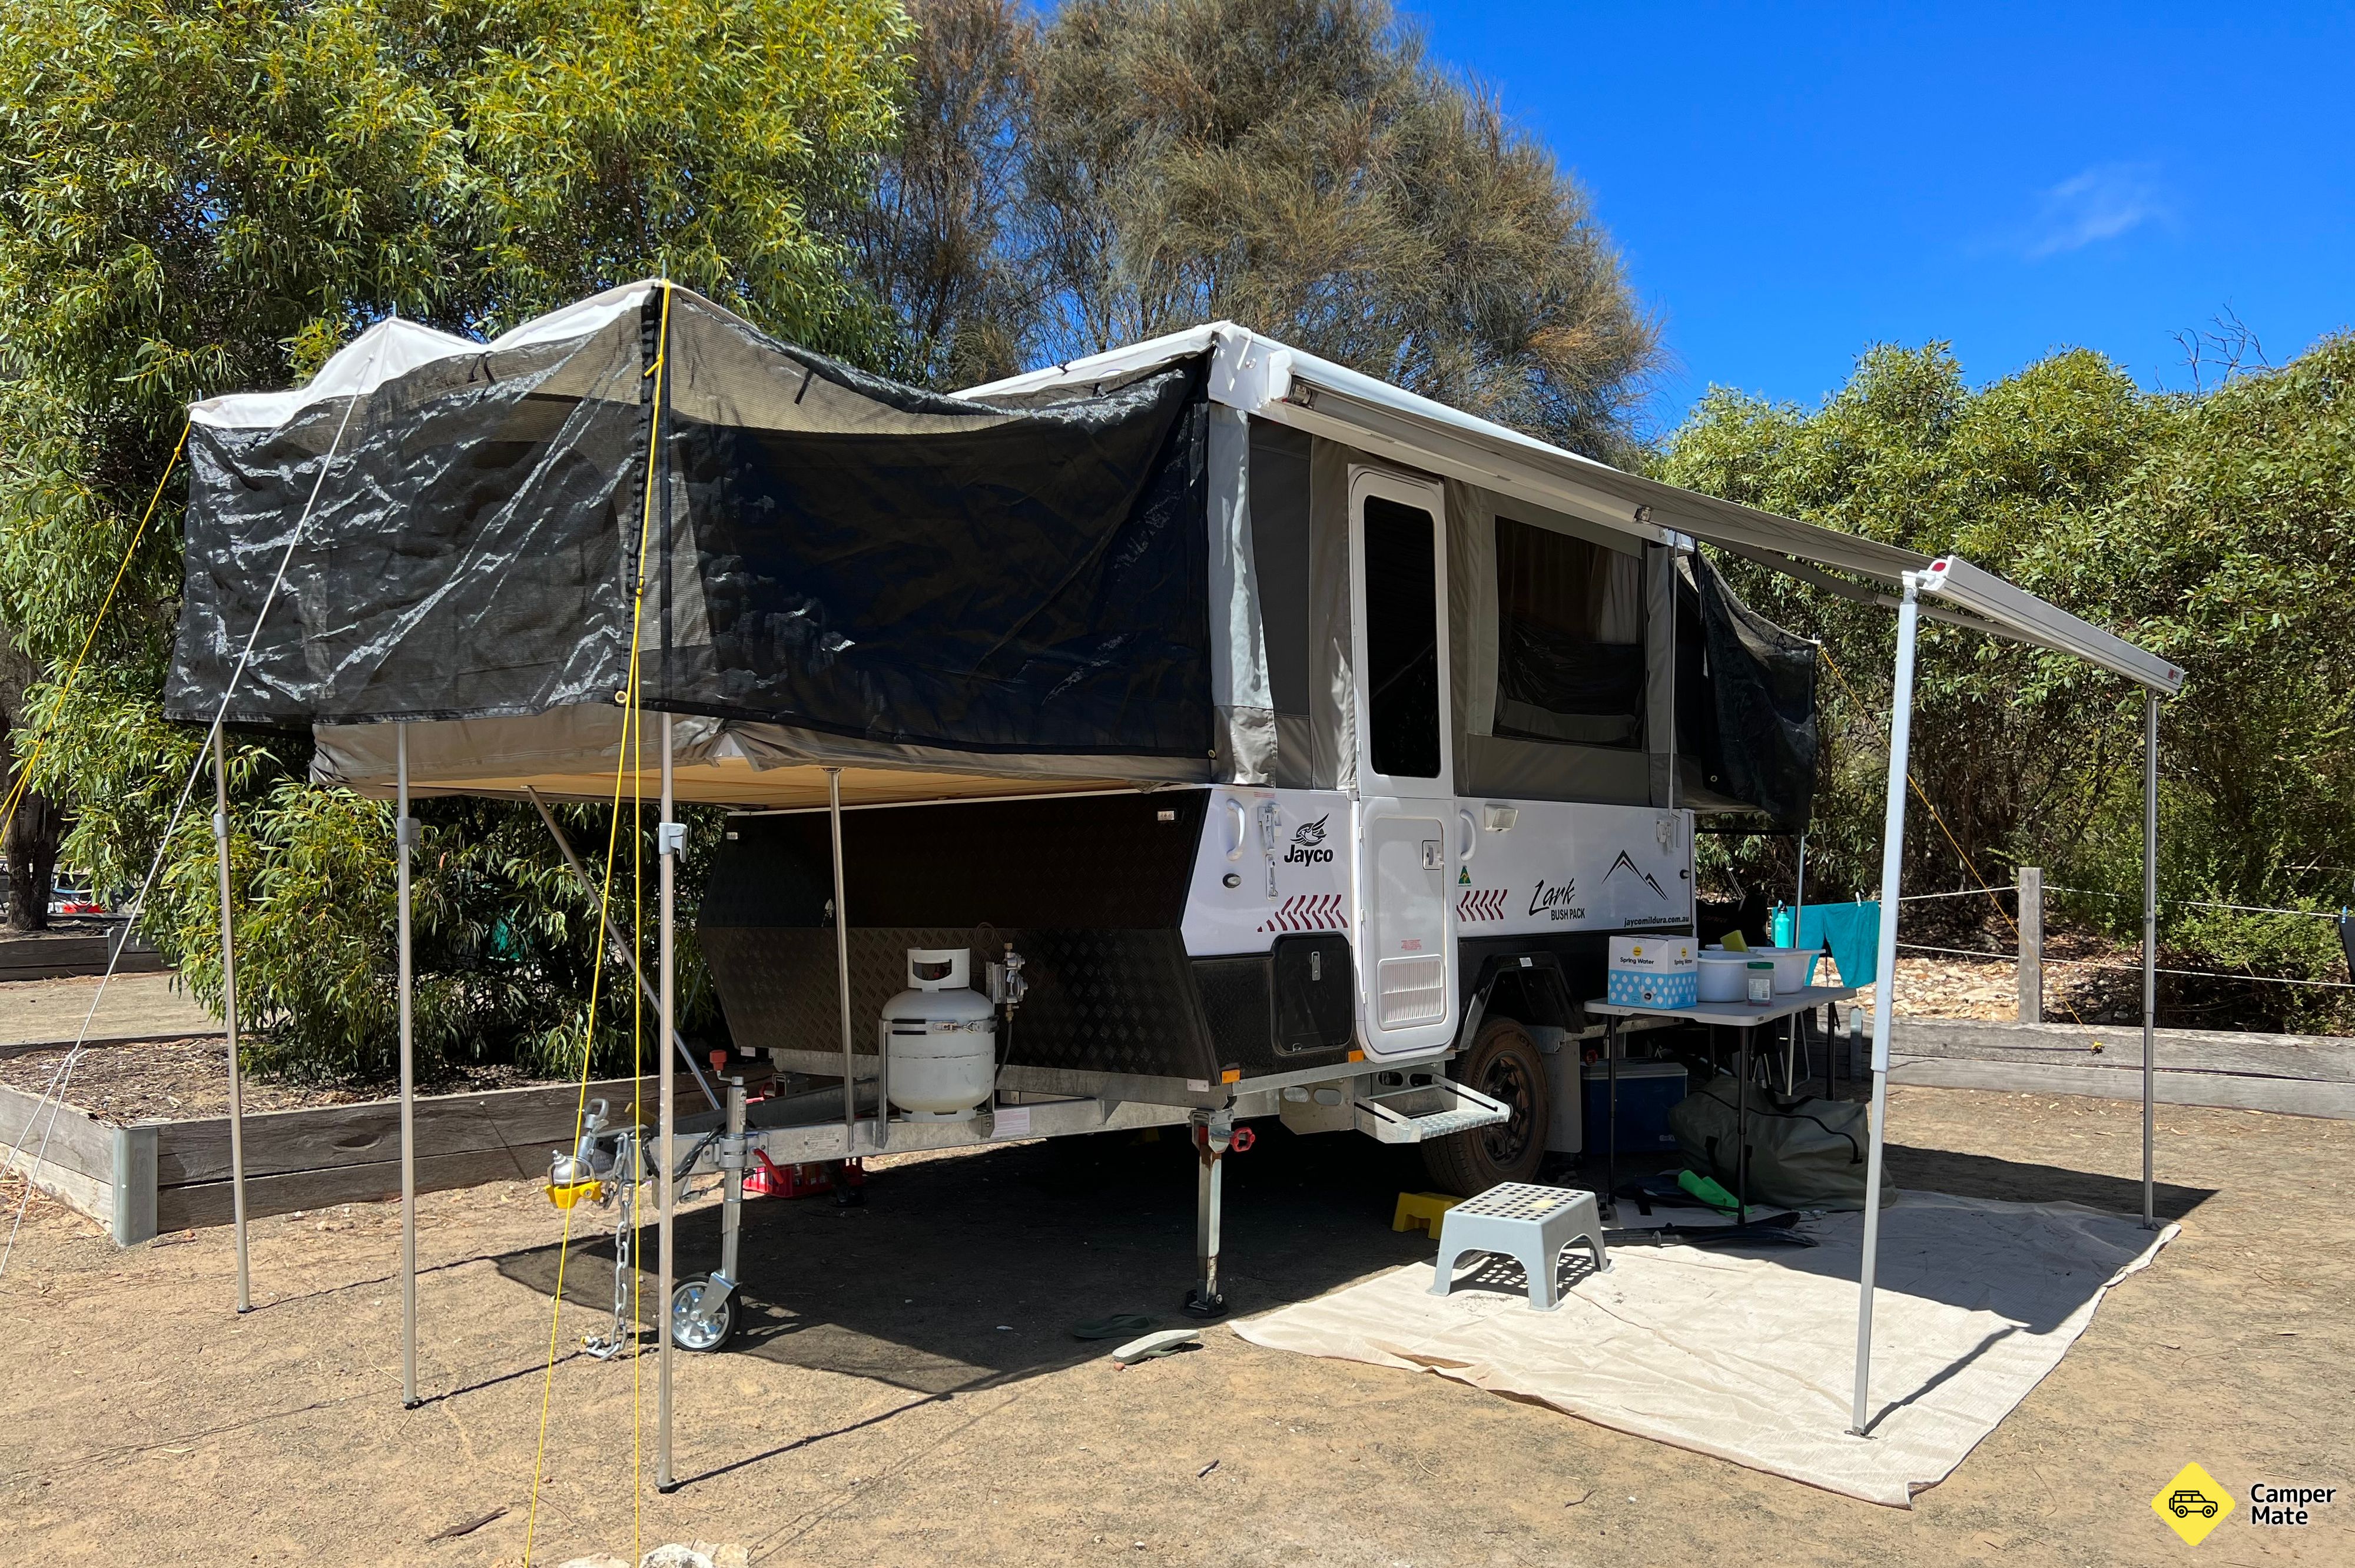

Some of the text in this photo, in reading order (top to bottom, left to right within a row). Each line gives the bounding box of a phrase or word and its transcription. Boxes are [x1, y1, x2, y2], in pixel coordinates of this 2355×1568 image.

[1284, 844, 1333, 866] Jayco
[1528, 878, 1575, 916] Lark
[1551, 908, 1586, 921] BUSH PACK
[1624, 916, 1689, 928] jaycomildura.com.au
[1620, 956, 1637, 965] Spring
